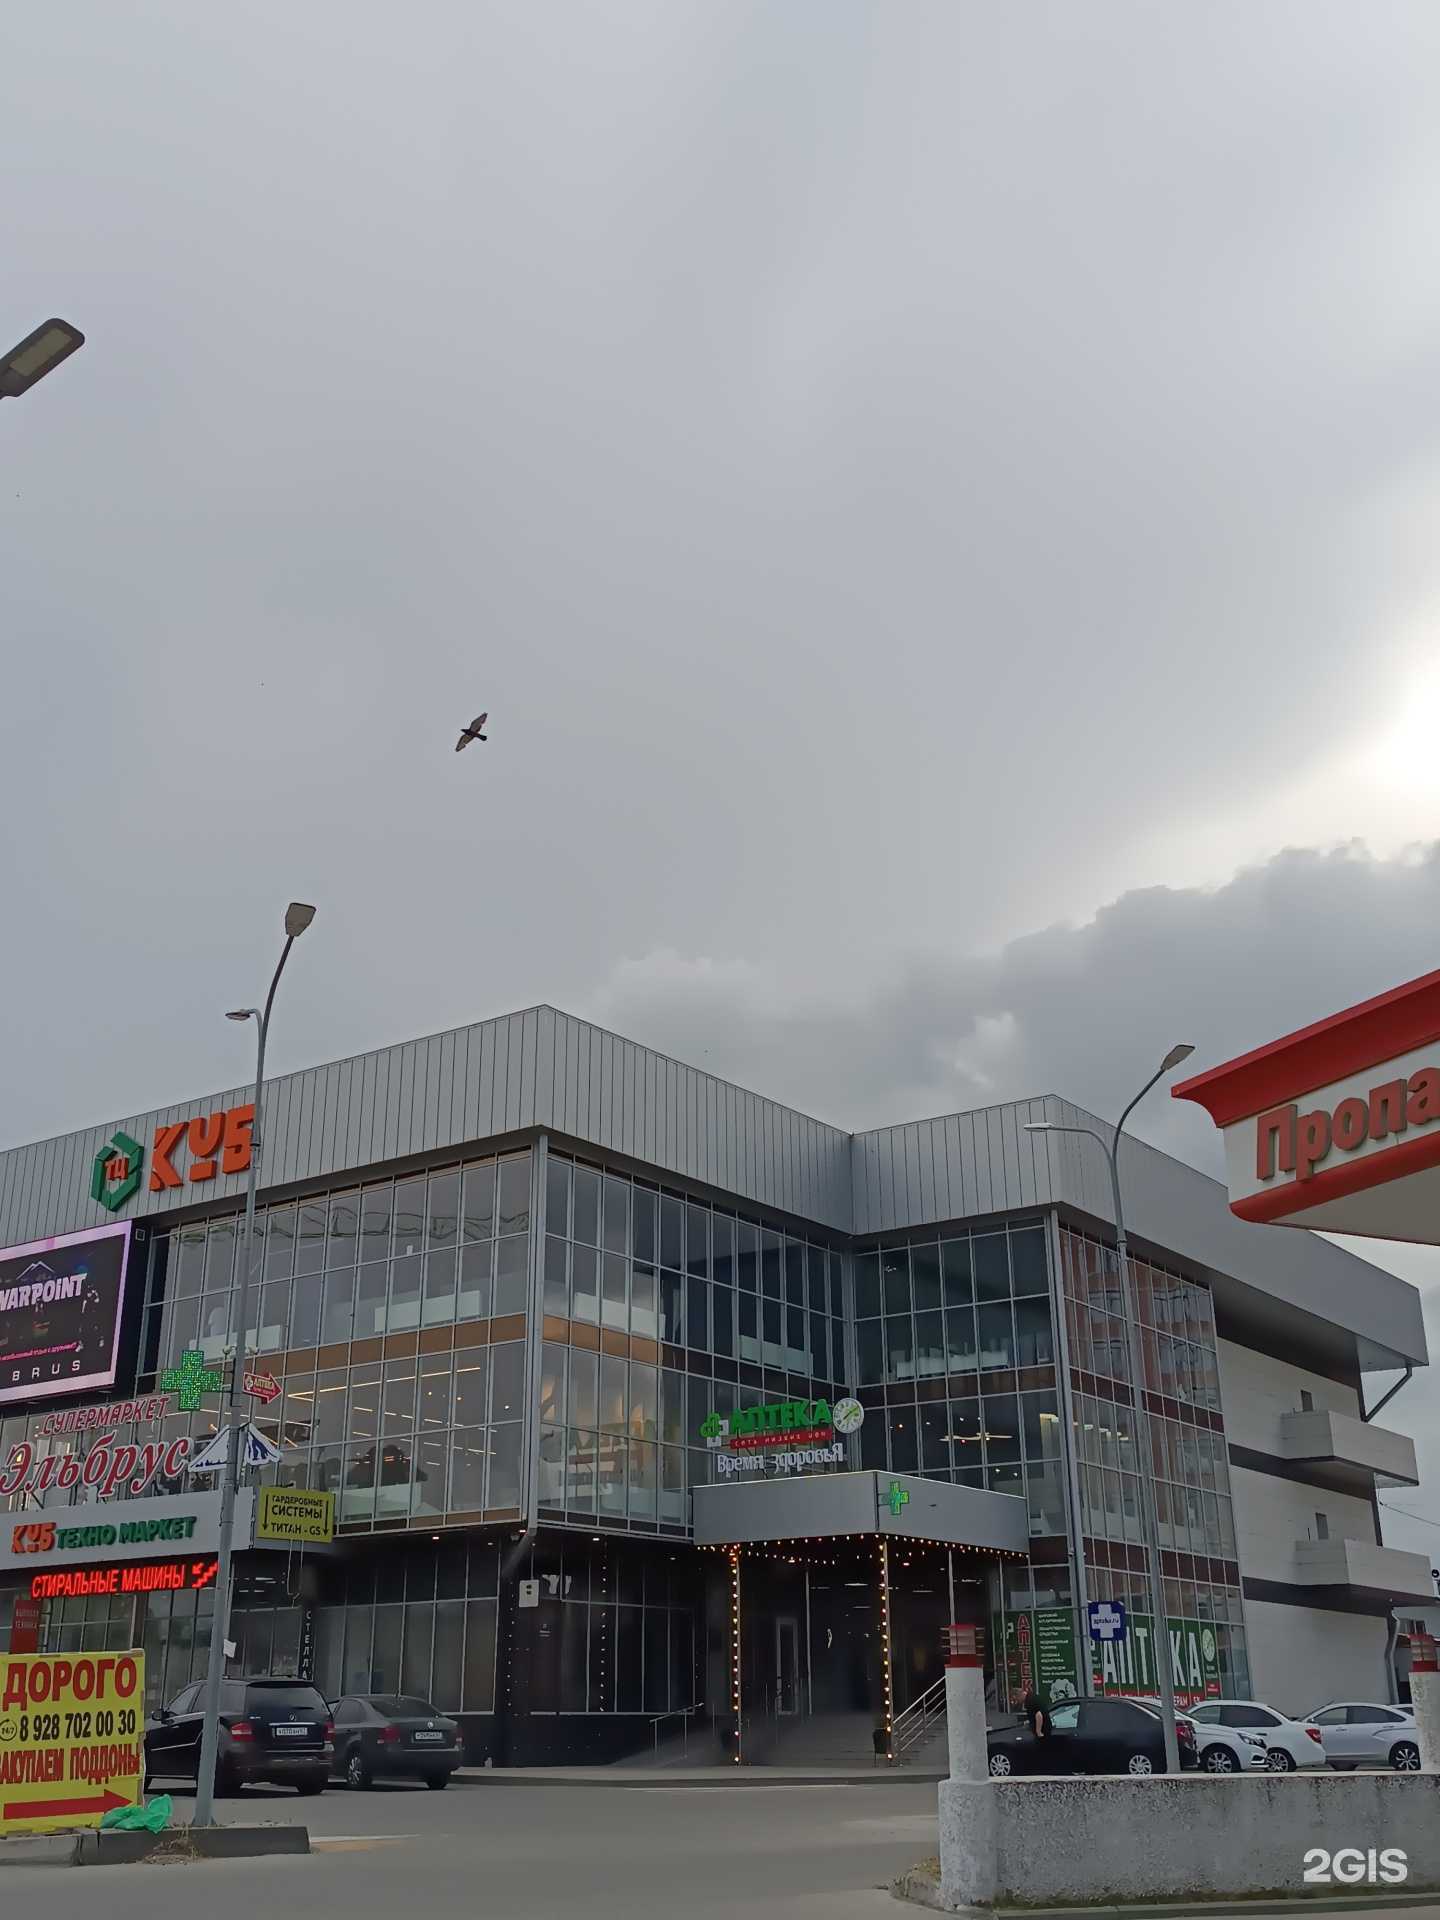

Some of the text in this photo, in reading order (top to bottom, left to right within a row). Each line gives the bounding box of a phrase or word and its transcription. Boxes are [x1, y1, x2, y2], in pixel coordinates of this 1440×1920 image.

[1257, 1067, 1440, 1180] Пропа
[149, 1104, 255, 1191] КУБ
[40, 1398, 168, 1435] СУПЕРМАРКЕТ
[730, 1399, 833, 1435] АПТЕКА
[0, 1430, 192, 1497] Эльбрус
[717, 1454, 764, 1478] Время
[271, 1504, 322, 1519] СИСТЕМЫ
[272, 1495, 323, 1507] ГАРДЕРОБНЫЕ
[11, 1516, 197, 1553] КУБ ТЕХНО МАРКЕТ
[271, 1522, 301, 1534] ТИТАН
[31, 1564, 186, 1598] СТИРАЛЬНЫЕ МАШИНЫ
[302, 1610, 312, 1680] СТЕЛЛА
[1103, 1626, 1202, 1687] АПТКА
[3, 1657, 137, 1711] ДОРОГО
[20, 1709, 136, 1741] 8 928 702 00 30
[70, 1743, 140, 1785] ПОДДОНЫ
